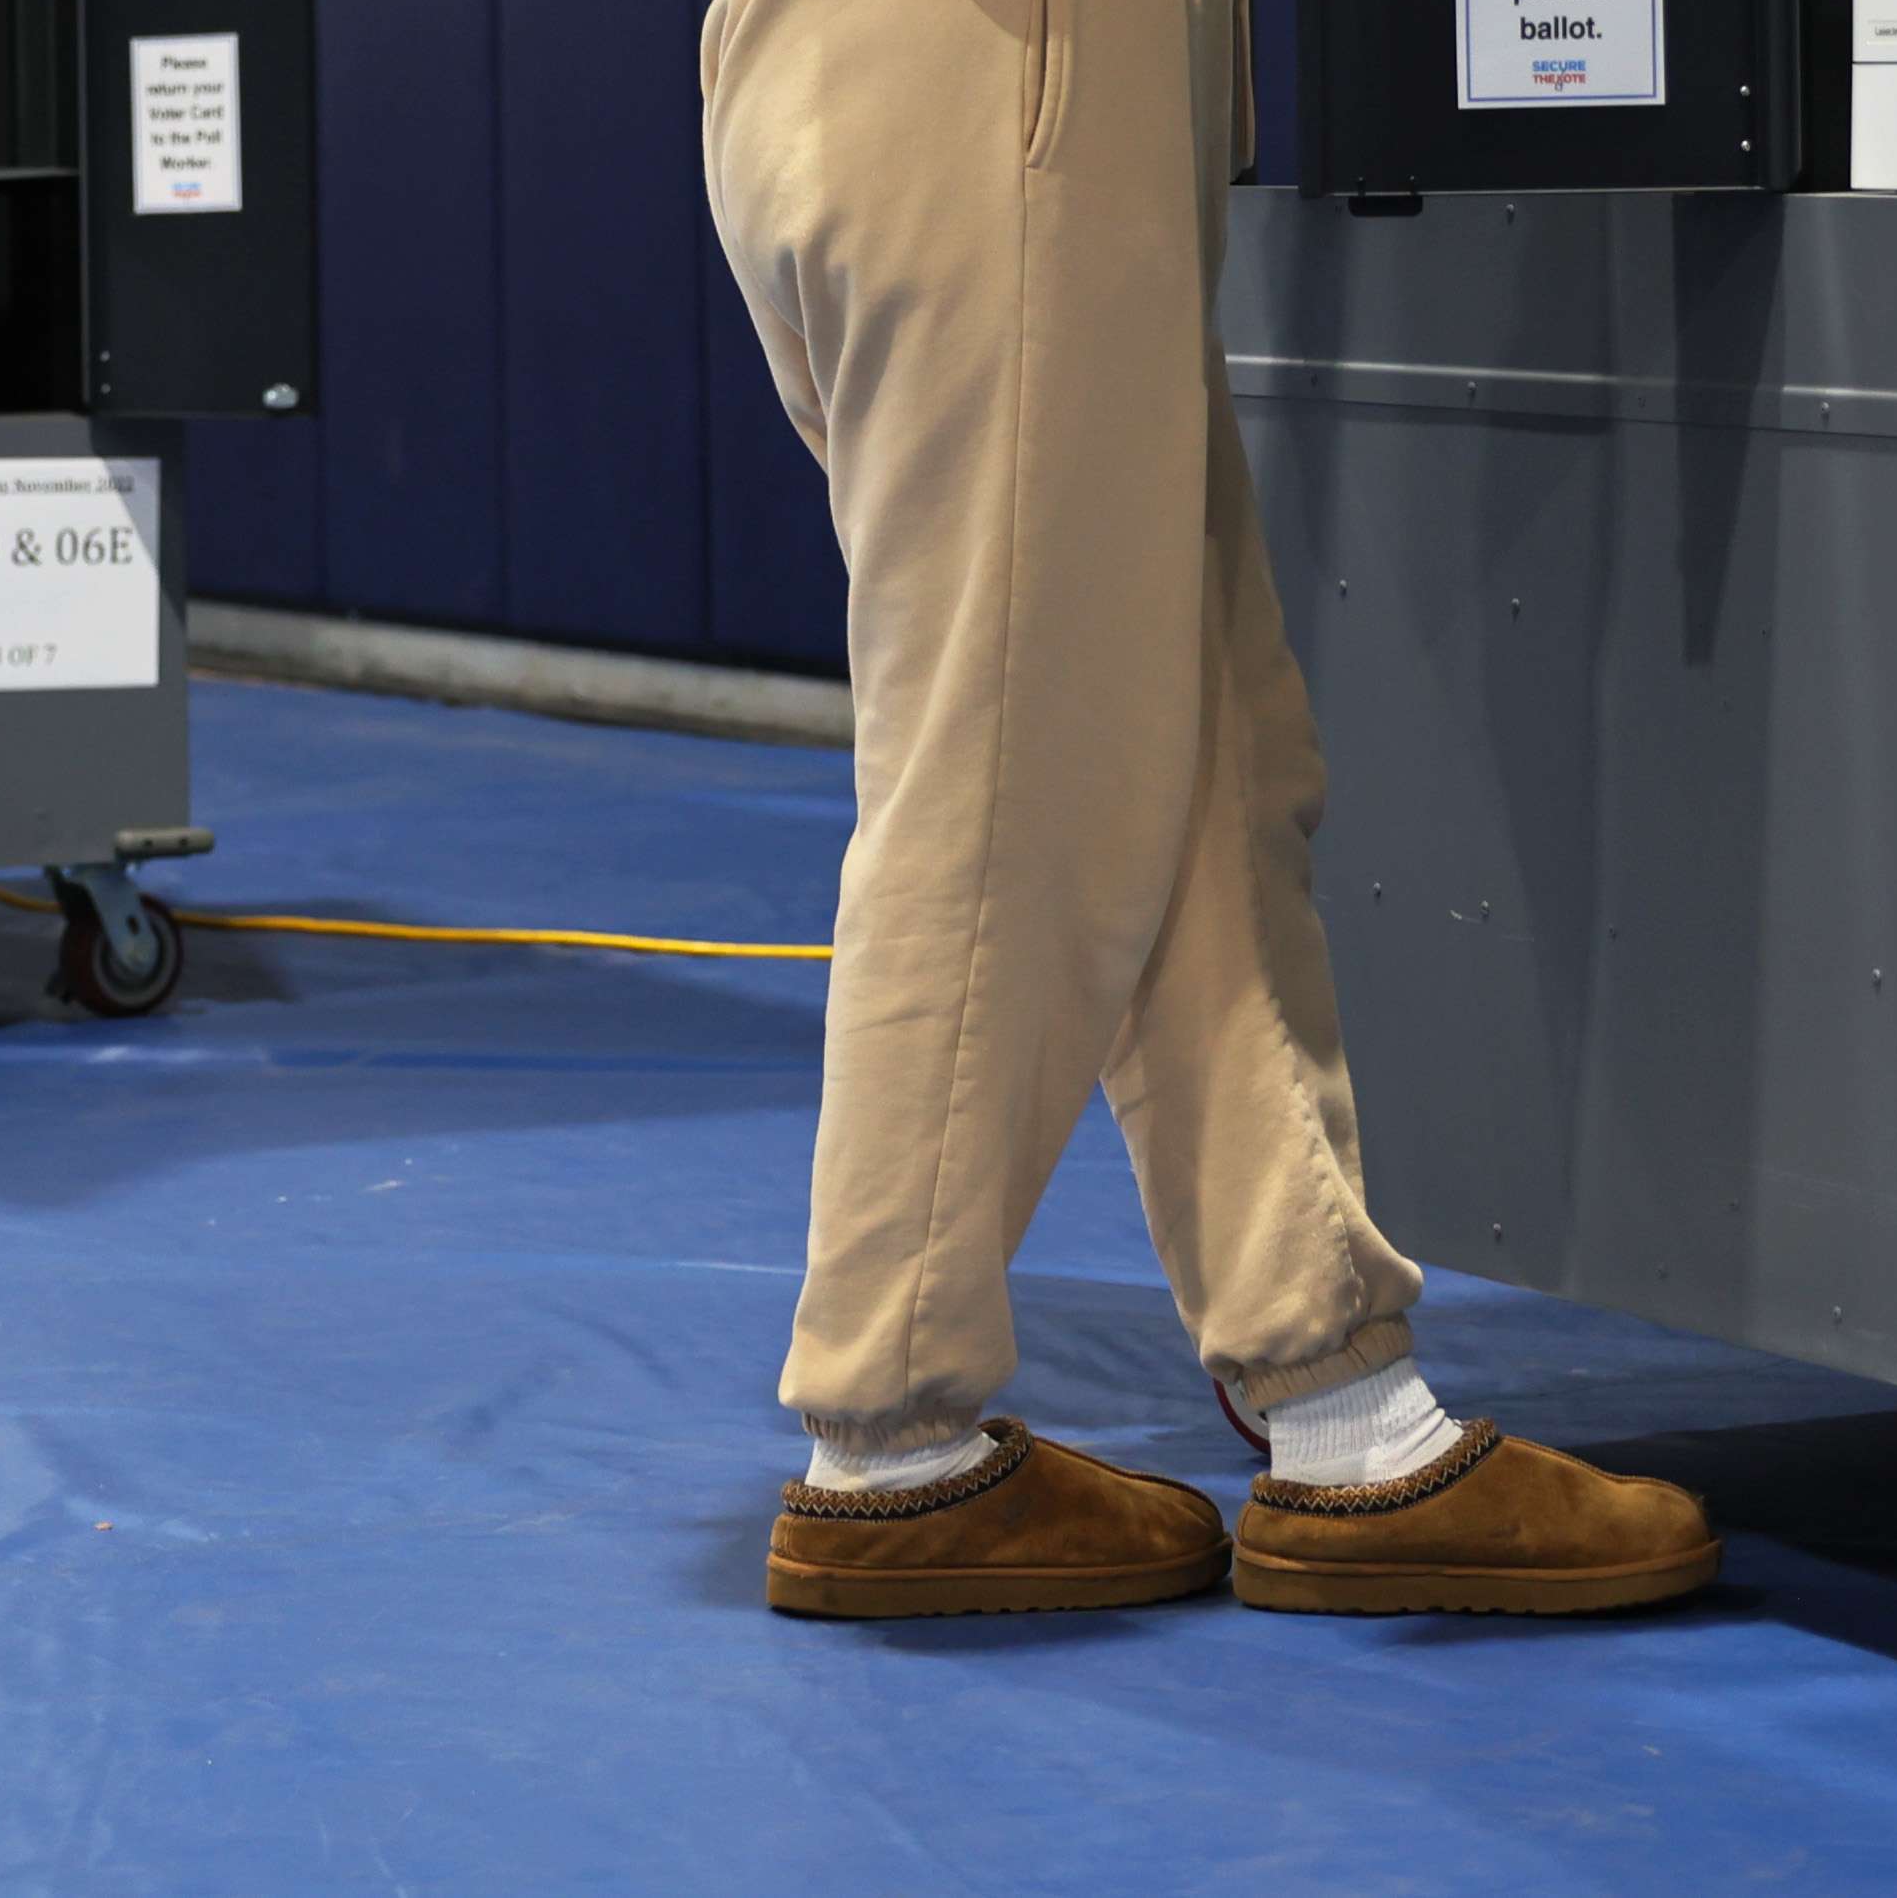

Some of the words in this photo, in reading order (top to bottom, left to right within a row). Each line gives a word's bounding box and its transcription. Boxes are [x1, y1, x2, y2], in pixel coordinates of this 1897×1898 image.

[1521, 16, 1601, 40] ballot.
[13, 478, 91, 493] November
[11, 528, 42, 566] &
[56, 527, 133, 565] 06E
[7, 647, 36, 666] OF
